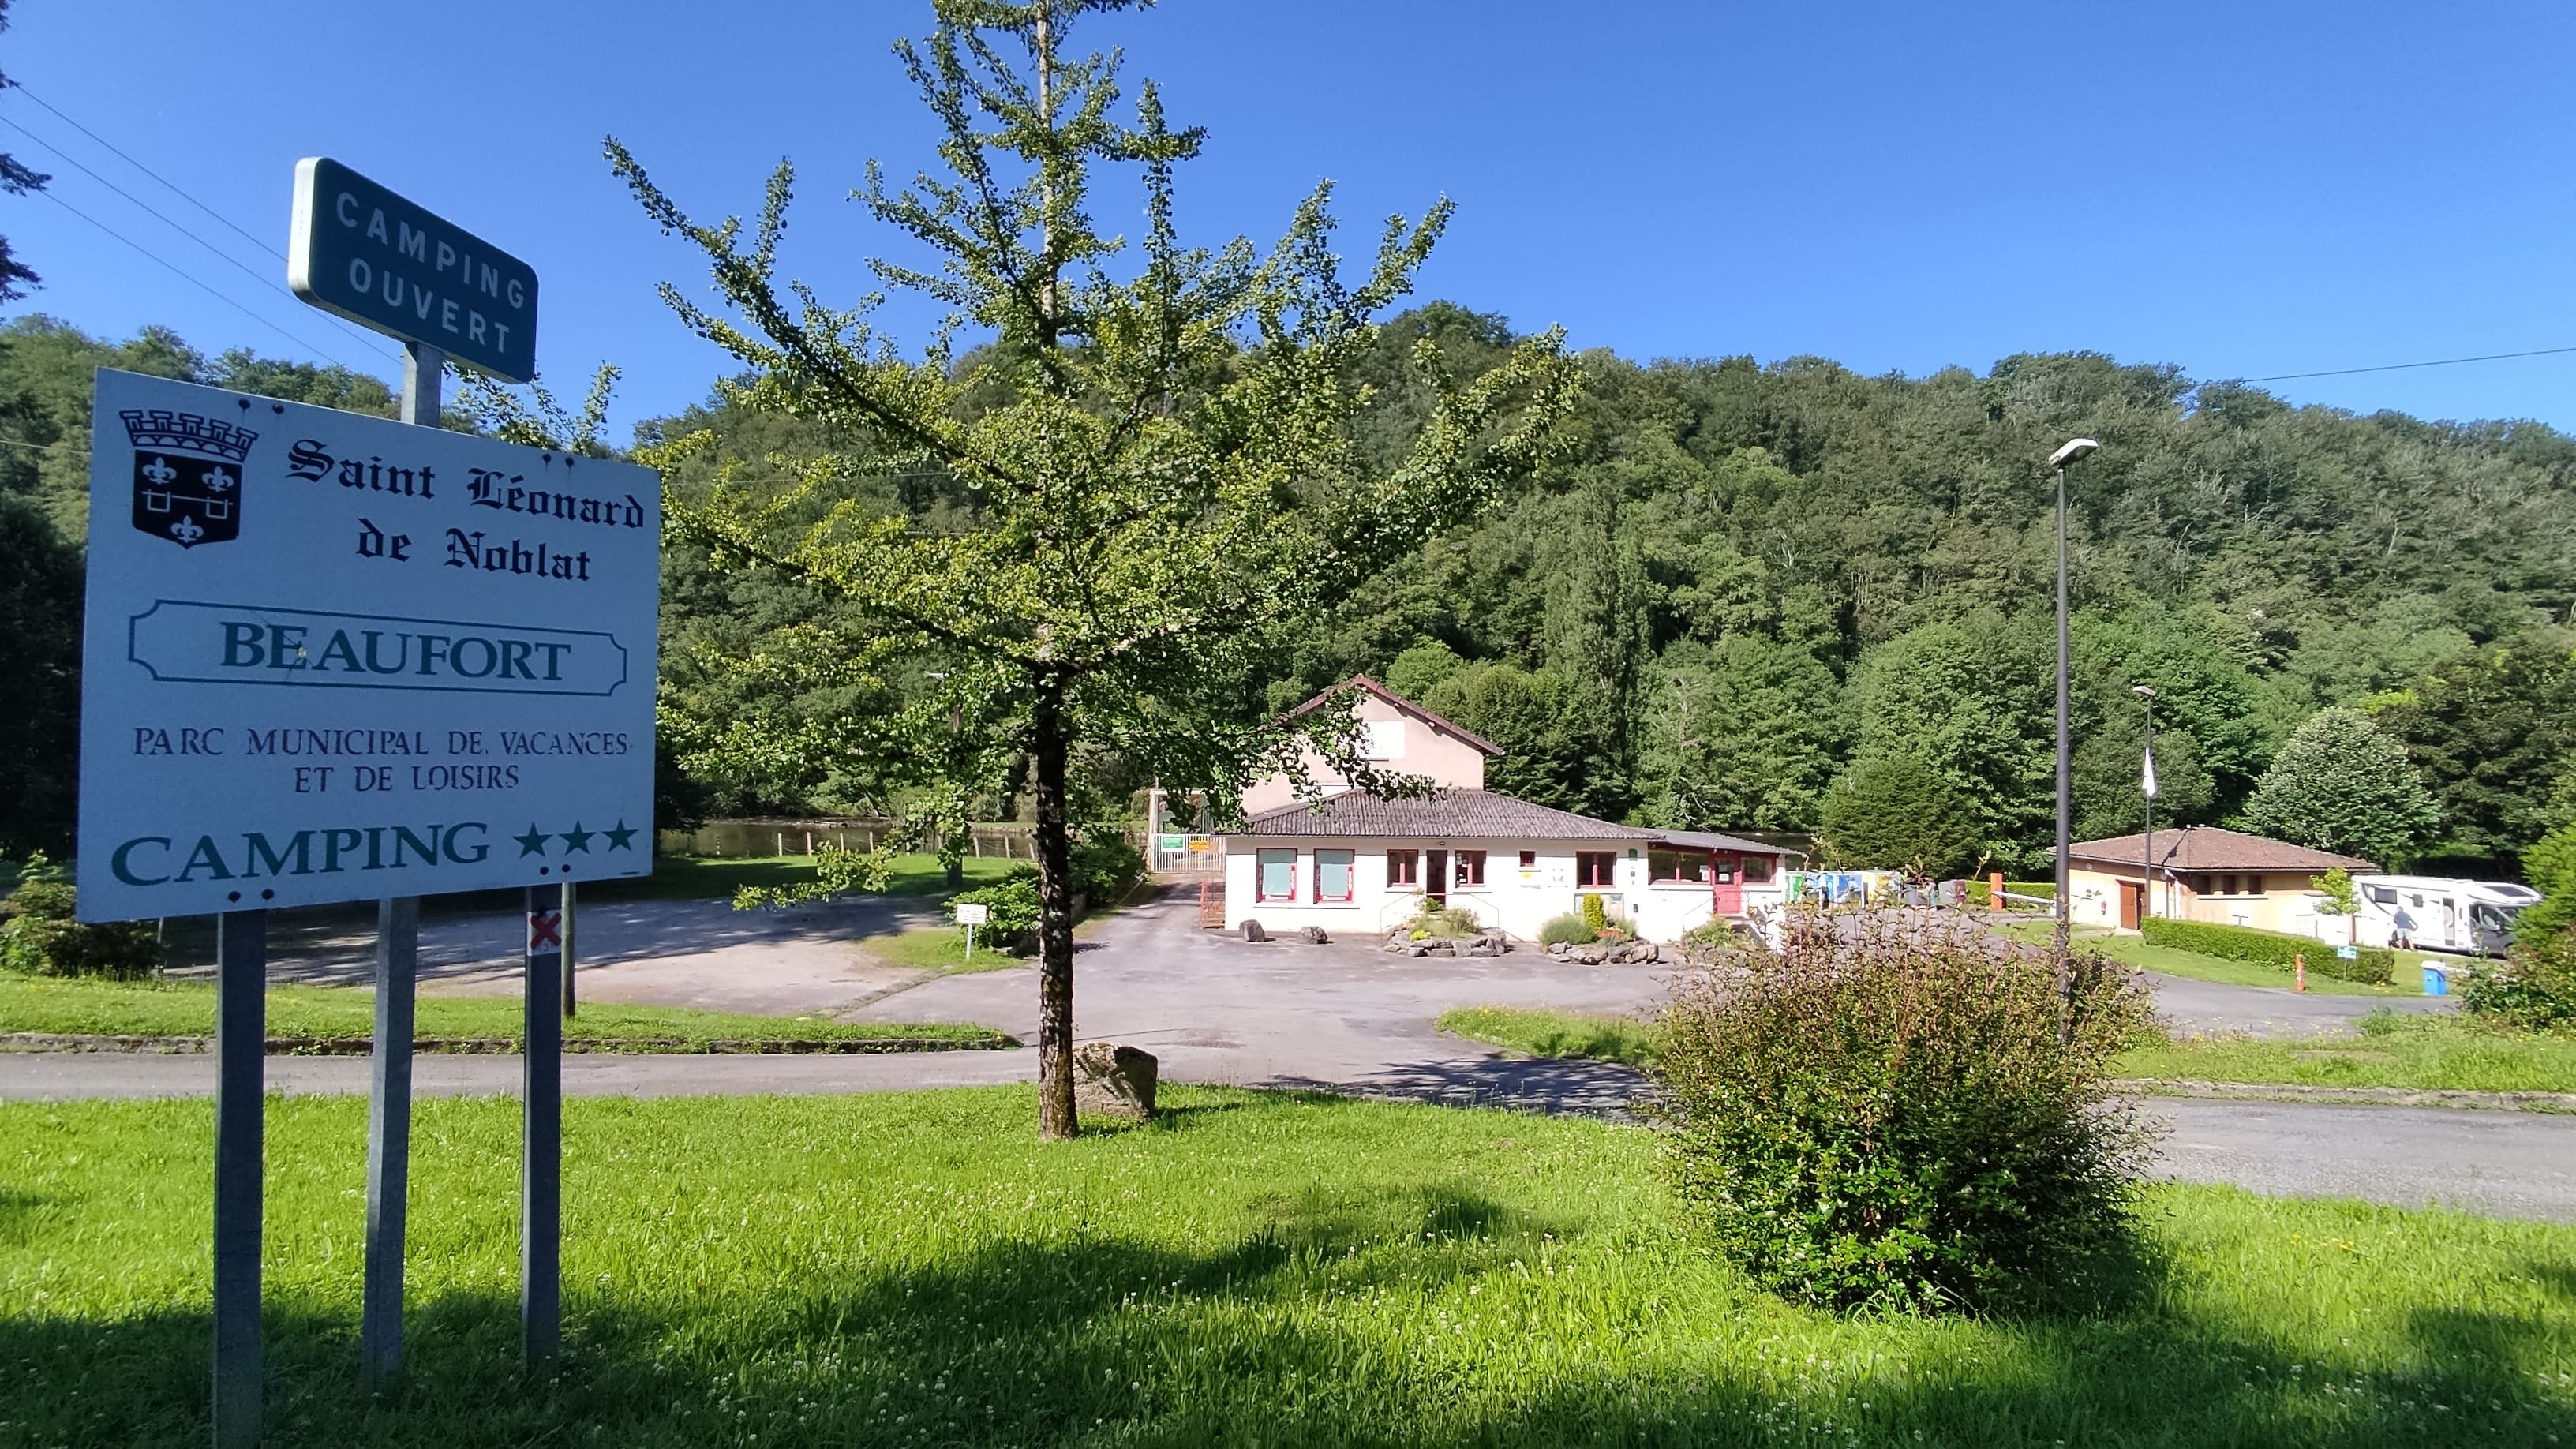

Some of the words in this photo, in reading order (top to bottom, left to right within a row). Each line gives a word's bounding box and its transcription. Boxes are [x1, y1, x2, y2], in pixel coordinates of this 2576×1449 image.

[335, 192, 525, 310] CAMPING
[349, 258, 511, 354] OUVERT
[286, 439, 436, 500] Saint
[466, 467, 645, 530] Léonard
[356, 519, 411, 562] de
[444, 527, 592, 582] Noblat
[220, 620, 572, 682] BEAUFORT
[133, 727, 225, 756] PARC
[245, 728, 429, 756] MUNICIPAL
[500, 731, 628, 755] VACANCES
[294, 766, 335, 793] ET
[353, 766, 394, 792] DE
[410, 764, 519, 791] LOISIRS
[111, 822, 491, 887] CAMPING
